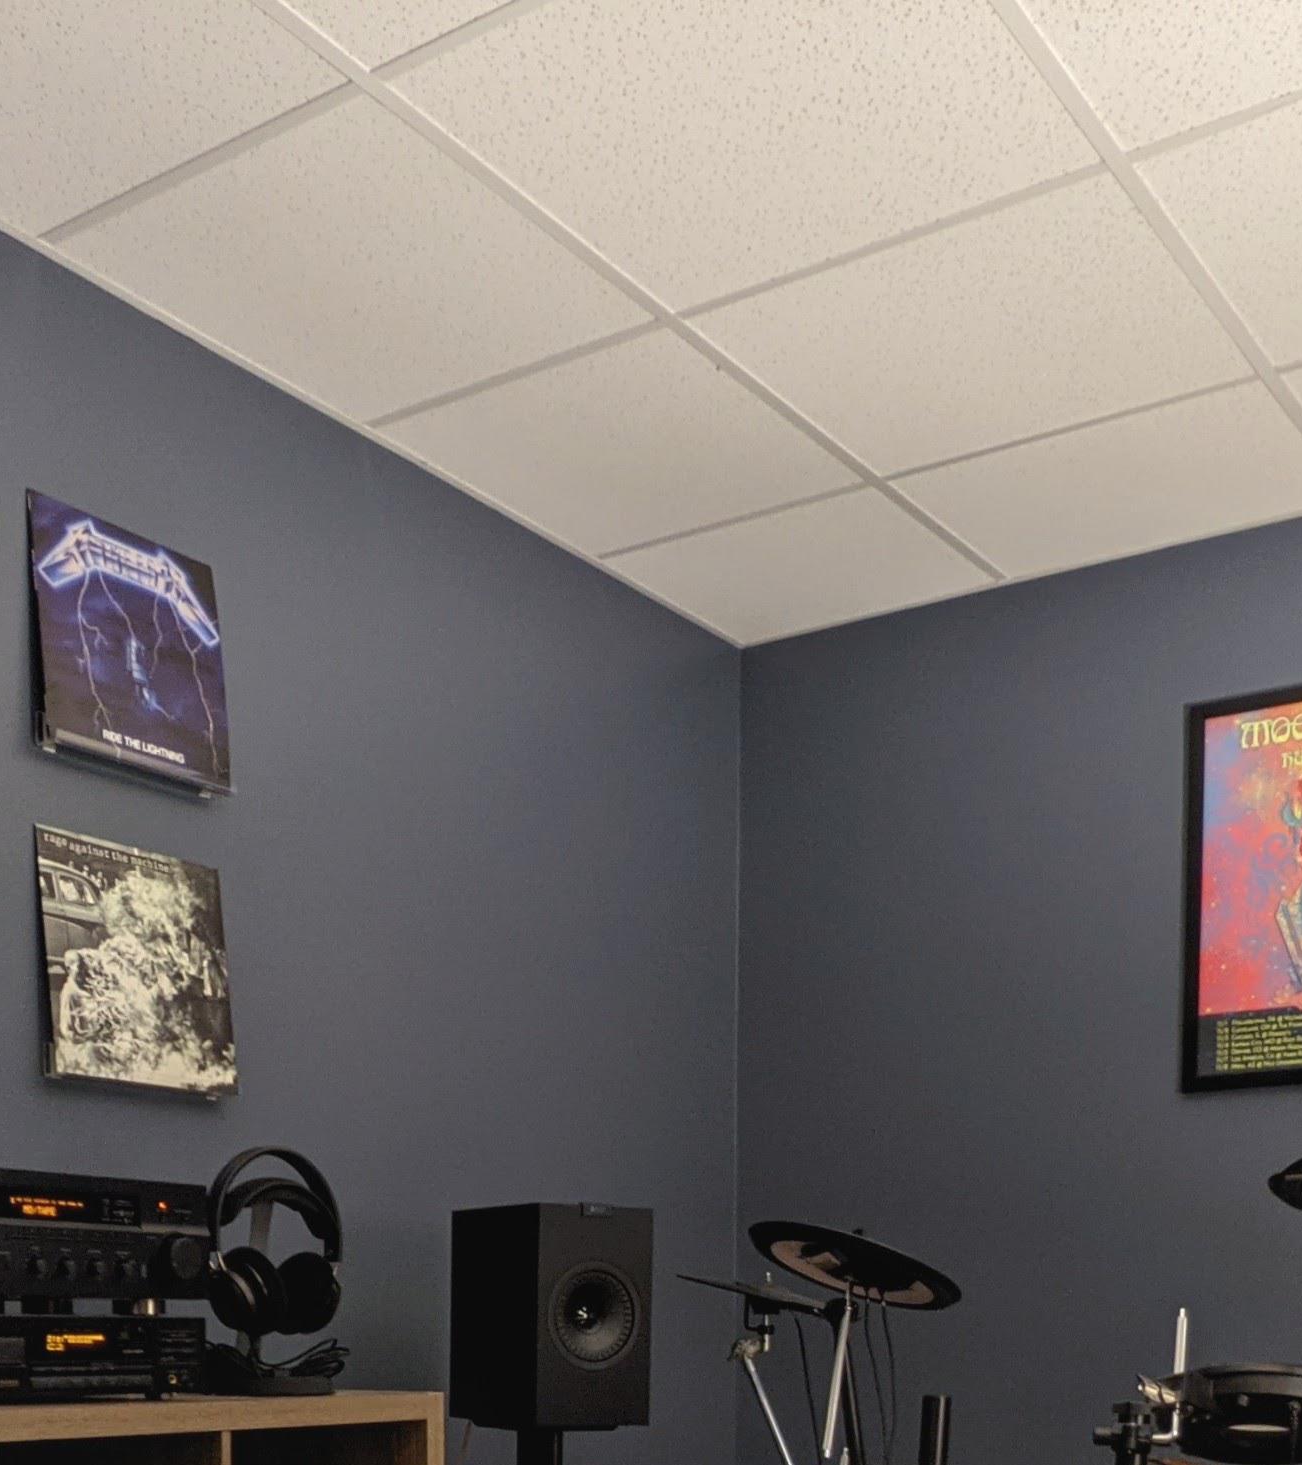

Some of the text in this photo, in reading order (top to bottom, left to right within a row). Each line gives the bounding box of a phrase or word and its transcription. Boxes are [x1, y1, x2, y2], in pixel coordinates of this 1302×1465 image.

[38, 519, 220, 648] METALLICA
[102, 729, 186, 765] RIDE THE LIGHTNING
[43, 832, 170, 874] rage against the machine
